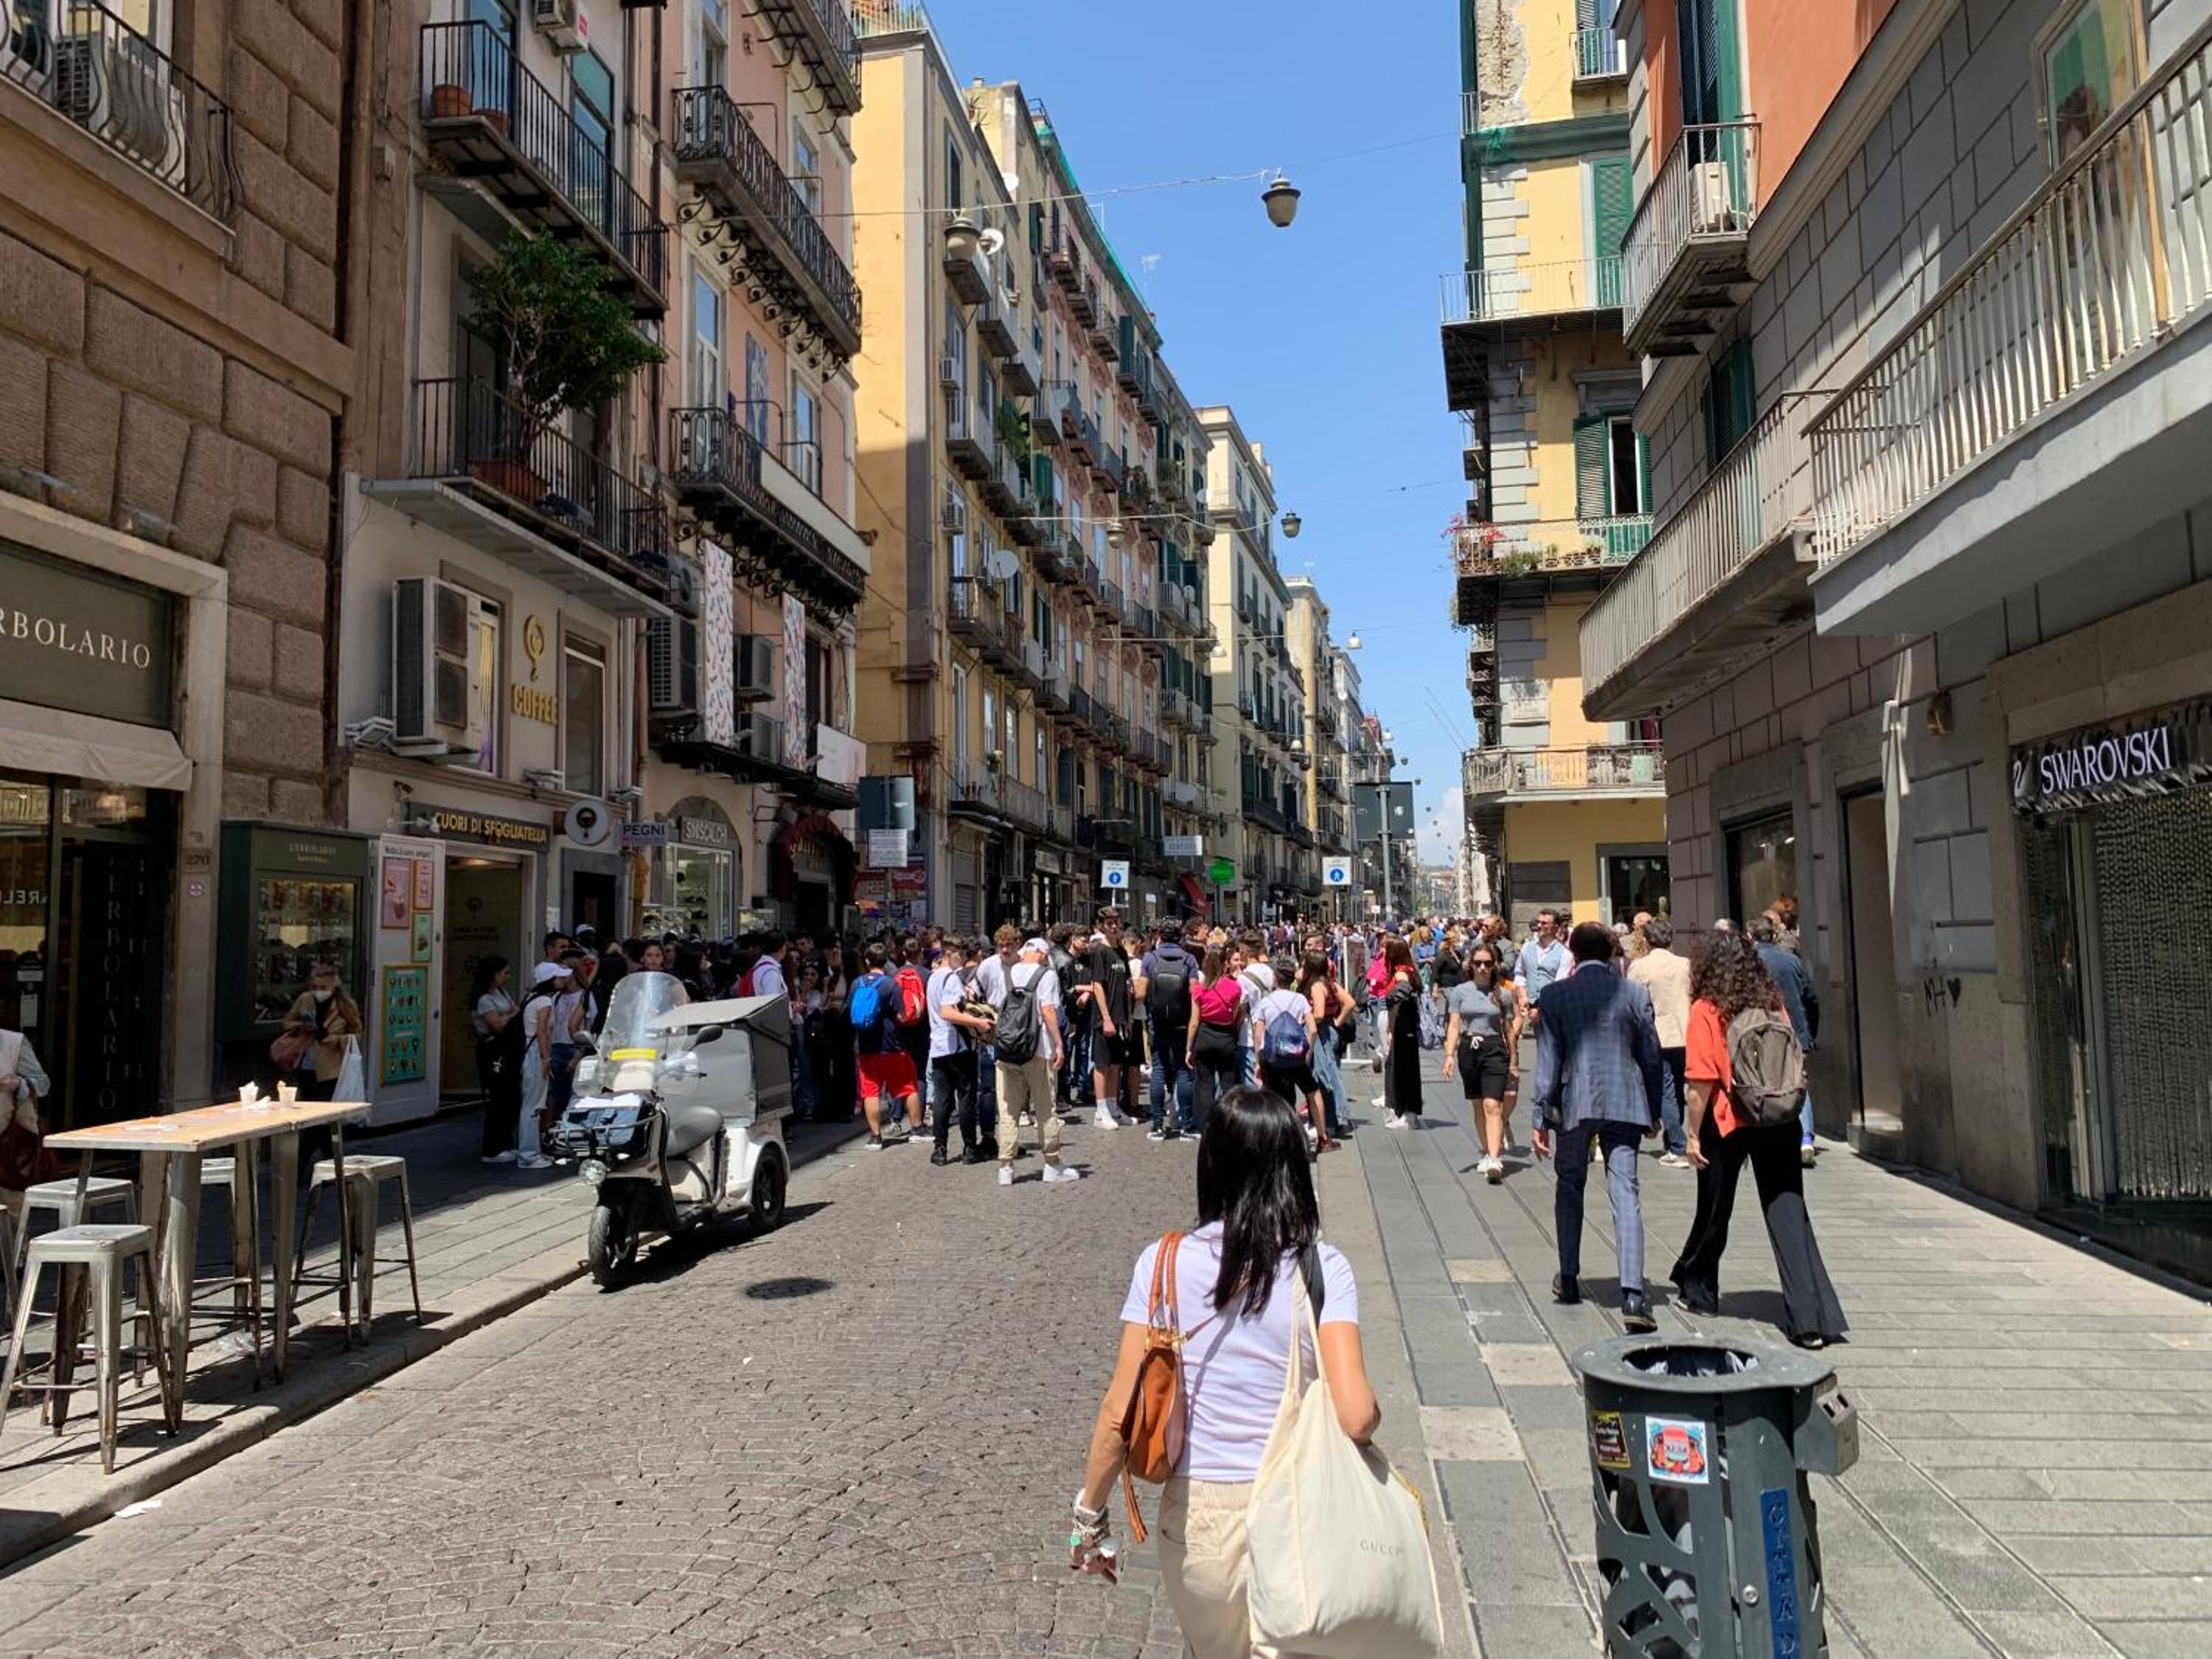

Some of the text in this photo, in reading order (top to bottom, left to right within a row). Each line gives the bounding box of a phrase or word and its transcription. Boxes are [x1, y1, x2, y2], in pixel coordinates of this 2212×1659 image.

[2040, 726, 2171, 795] SWAROVSKI
[434, 813, 548, 843] CUORI DI SFOGLIATELLA
[623, 825, 664, 836] PEGNI
